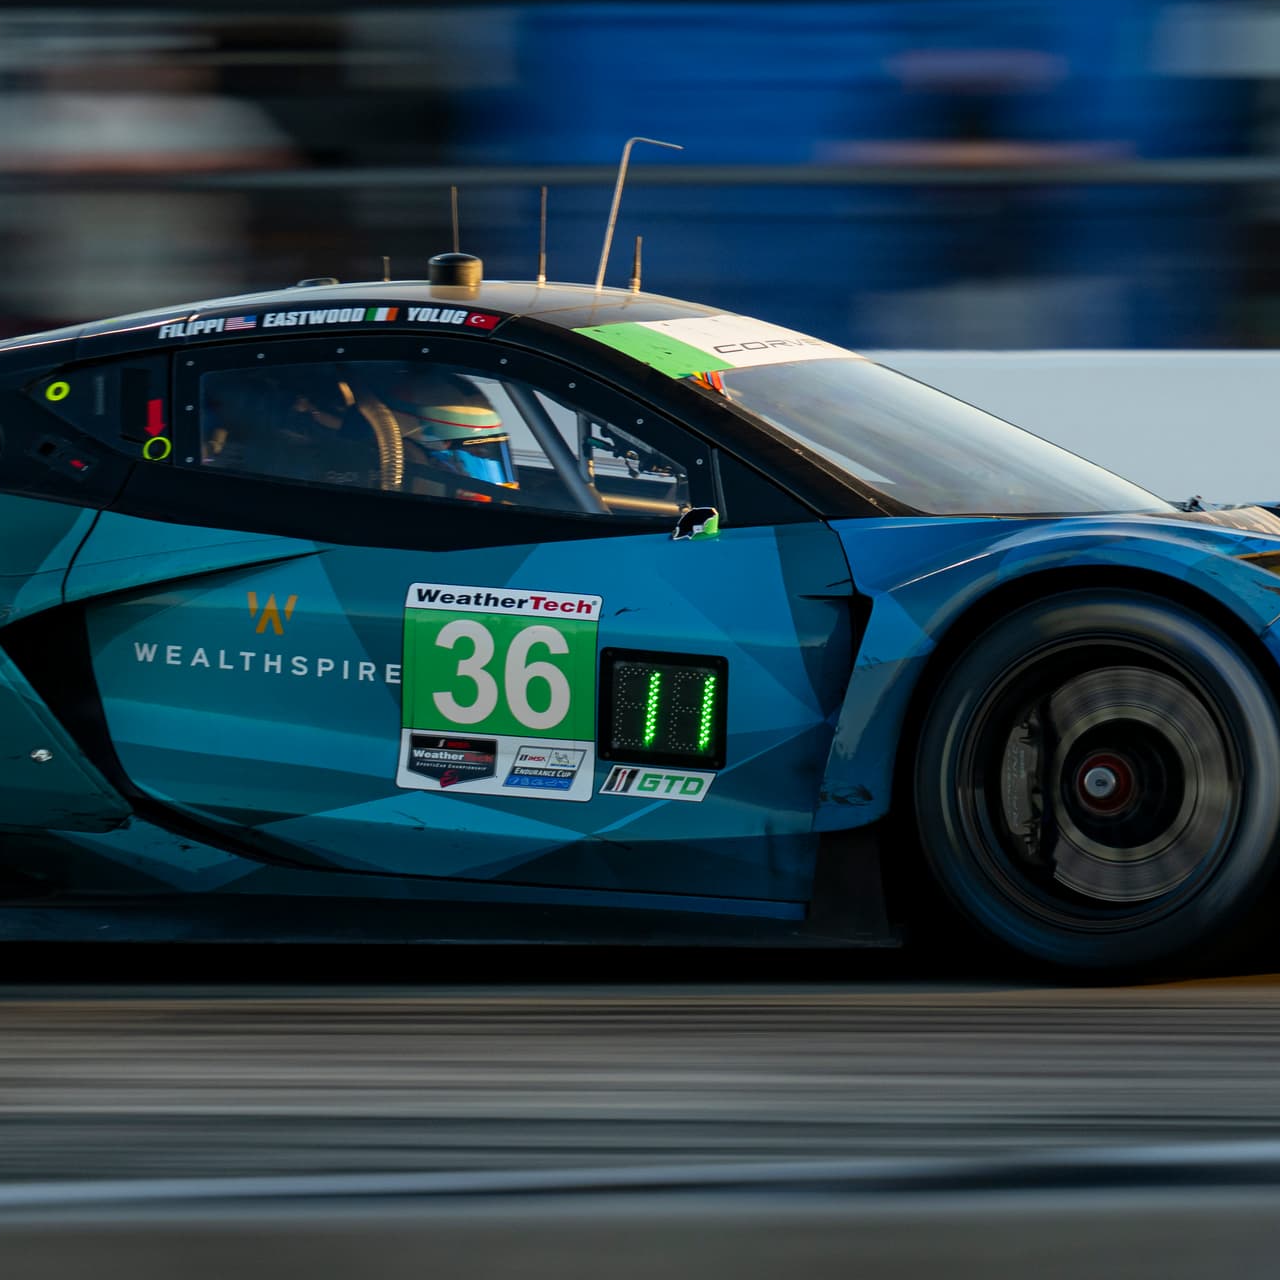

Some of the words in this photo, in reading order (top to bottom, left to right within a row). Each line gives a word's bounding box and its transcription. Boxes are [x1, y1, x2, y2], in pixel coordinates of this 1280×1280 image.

[158, 318, 225, 340] FILIPPI
[262, 308, 366, 328] EASTWOOD
[416, 588, 594, 615] WeatherTech
[134, 641, 402, 685] WEALTHSPIRE
[432, 619, 571, 731] 36
[637, 773, 705, 796] GTD
